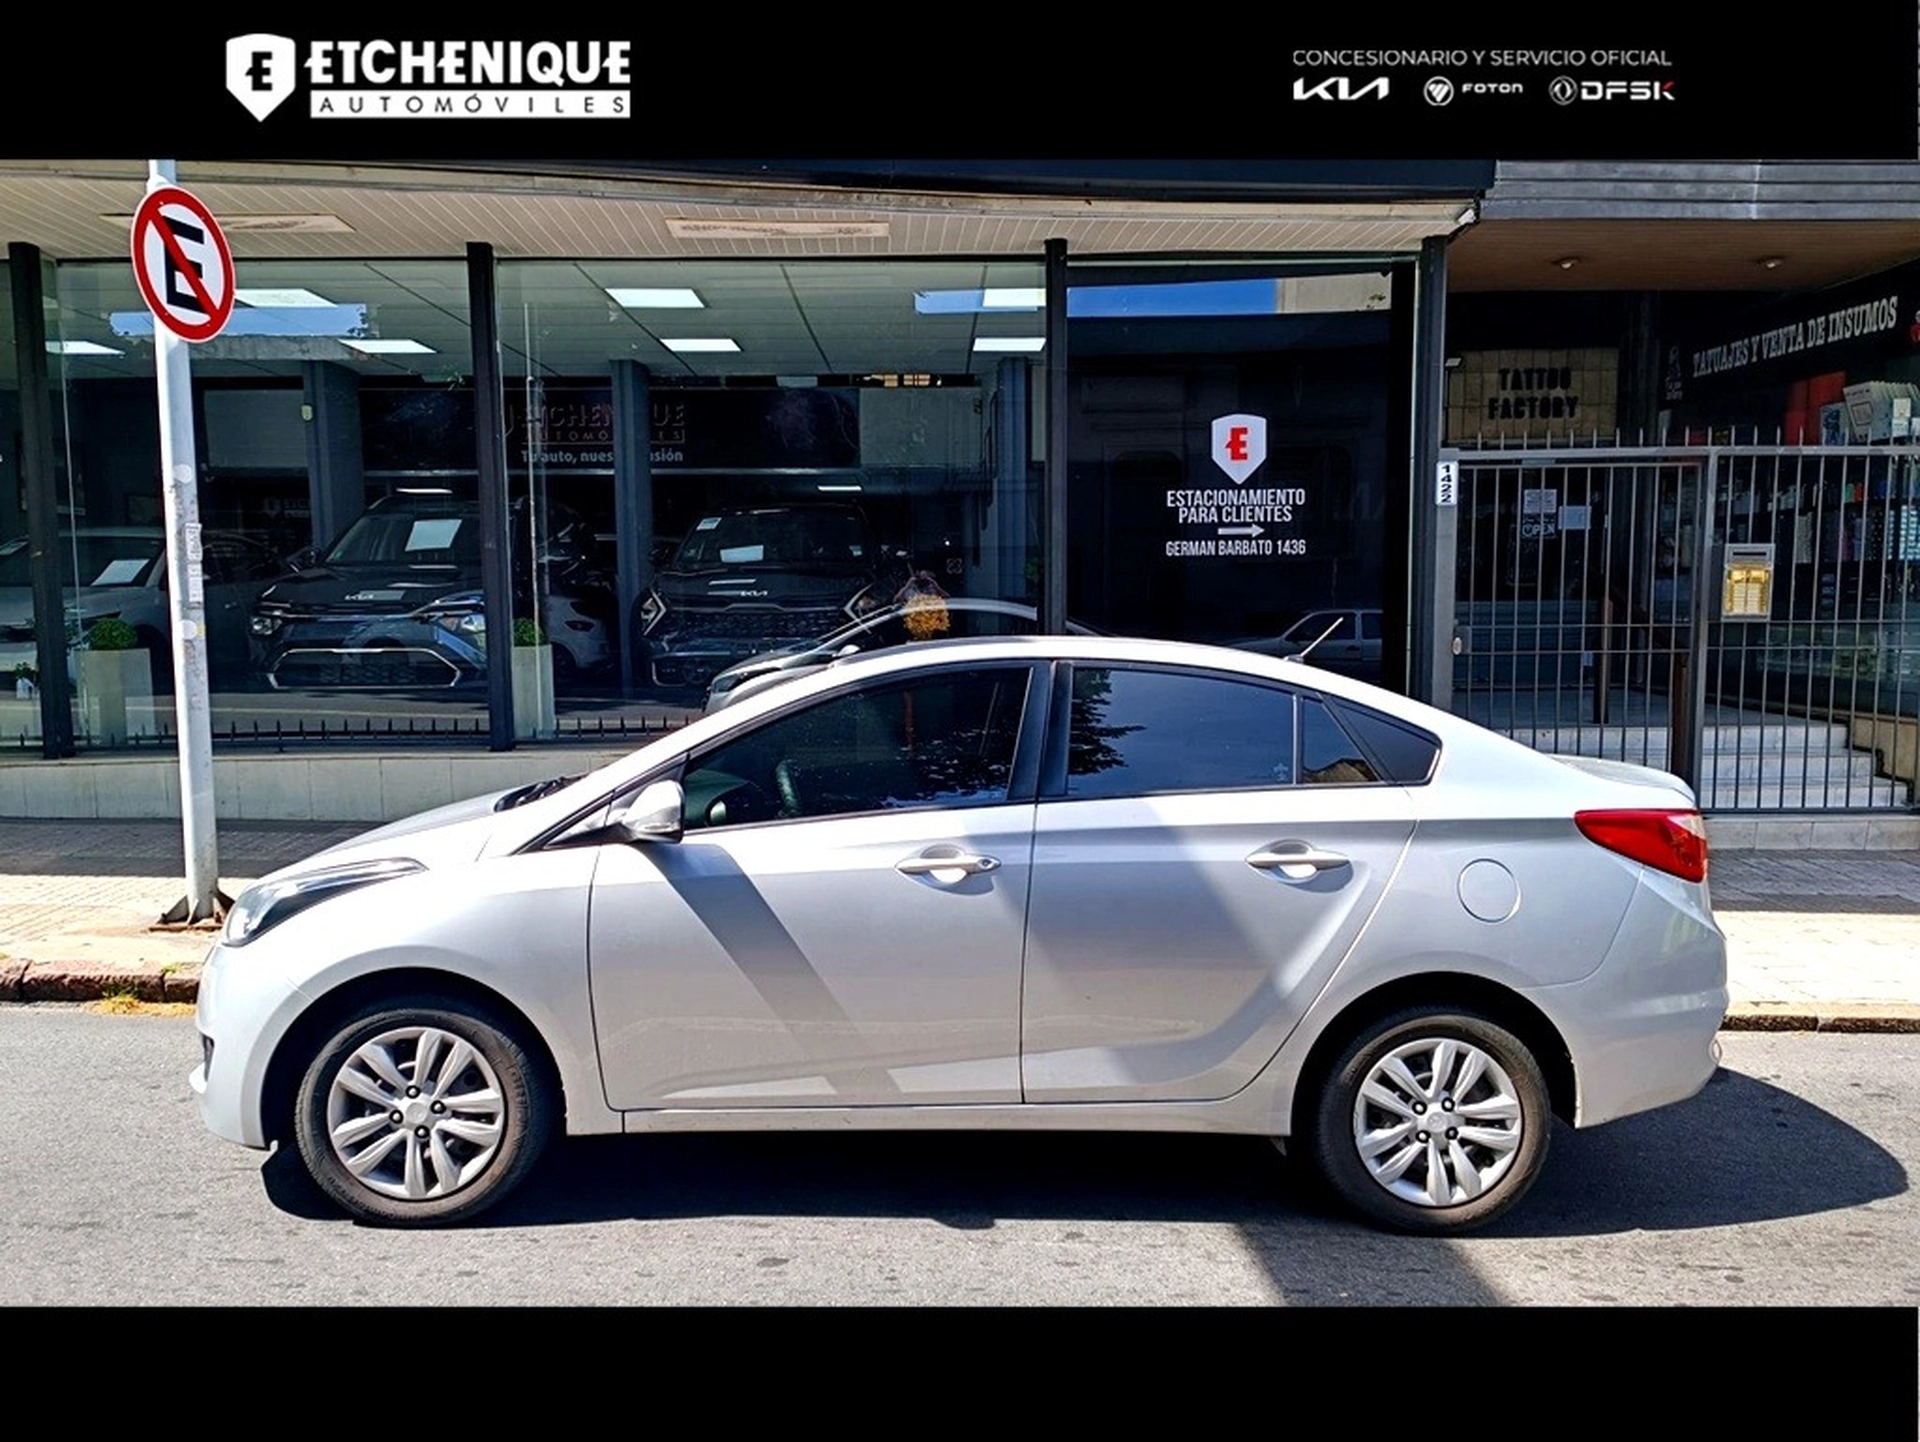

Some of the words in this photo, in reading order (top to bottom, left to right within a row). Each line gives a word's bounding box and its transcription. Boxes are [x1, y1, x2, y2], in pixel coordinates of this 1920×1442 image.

[1692, 338, 1750, 378] TATUAJES
[1749, 335, 1763, 363] Y
[1761, 322, 1805, 360] VENTA
[1806, 315, 1826, 348] DE
[1826, 296, 1898, 343] INSUMOS
[1499, 367, 1572, 391] TATTOO
[1488, 396, 1579, 420] FACTORY
[539, 449, 577, 463] auto,
[580, 450, 613, 462] nues
[1440, 464, 1453, 503] 1422
[1166, 488, 1306, 507] ESTACIONAMIENTO
[1178, 506, 1219, 524] PARA
[1221, 505, 1293, 523] CLIENTES
[1165, 540, 1216, 556] GERMAN
[1217, 539, 1273, 556] BARBATO
[1276, 539, 1307, 555] 1436
